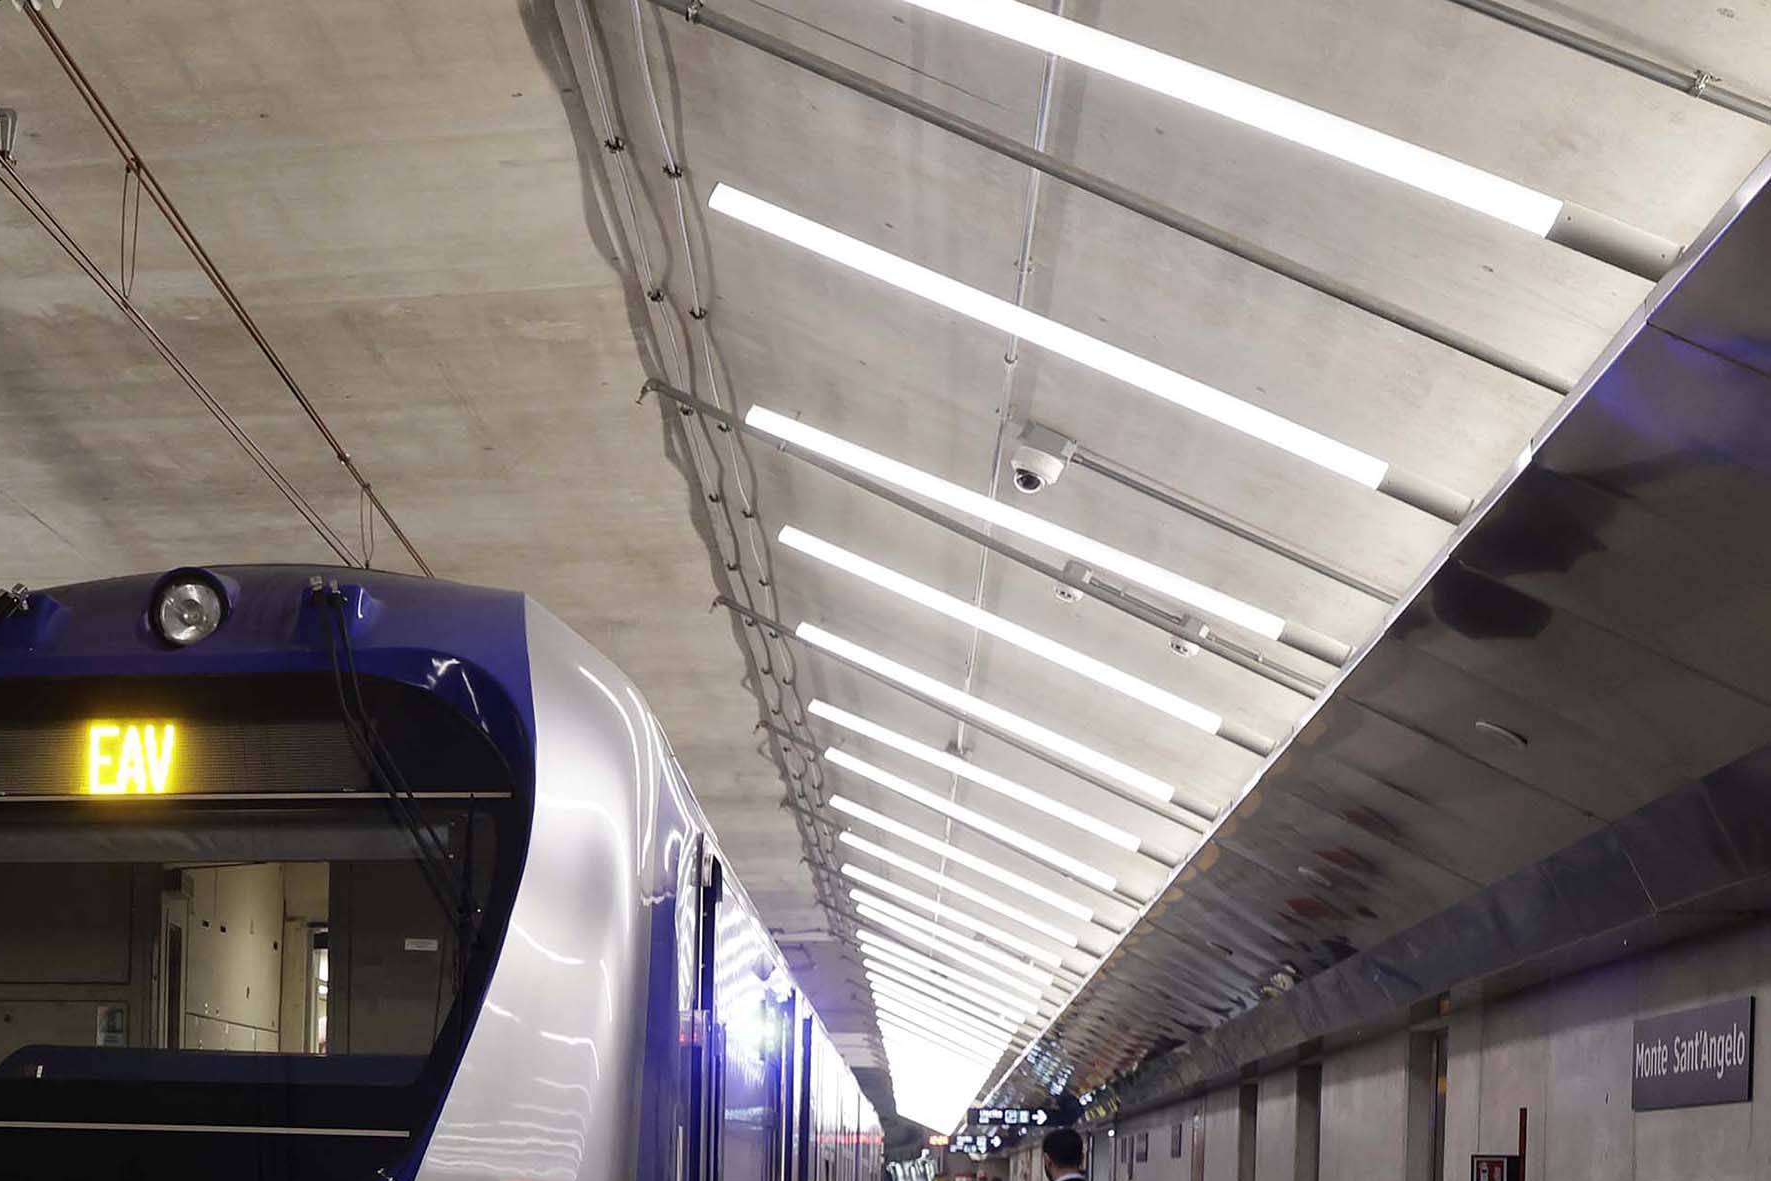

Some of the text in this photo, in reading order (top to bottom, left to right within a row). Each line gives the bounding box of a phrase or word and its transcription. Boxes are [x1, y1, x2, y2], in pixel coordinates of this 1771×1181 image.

[88, 724, 176, 794] EAV
[1635, 1021, 1746, 1080] Monte Sant'Angelo
